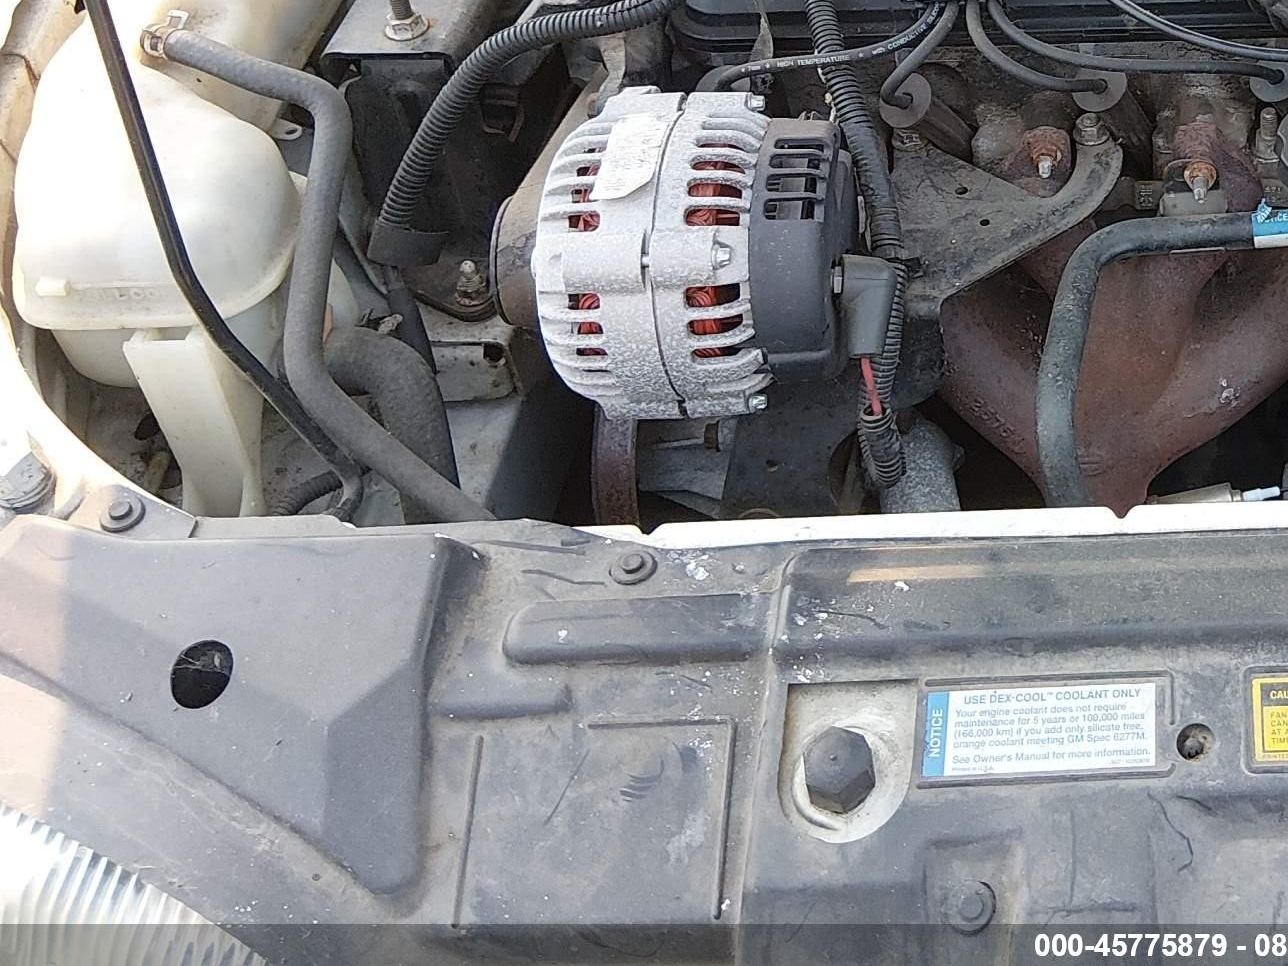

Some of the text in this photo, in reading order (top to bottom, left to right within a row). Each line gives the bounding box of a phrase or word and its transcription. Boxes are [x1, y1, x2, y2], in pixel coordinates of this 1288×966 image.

[777, 60, 794, 68] HIGH
[797, 54, 850, 66] TEMPERATURE
[964, 693, 986, 705] USE
[1056, 690, 1108, 701] COOLANT
[1112, 688, 1142, 699] ONLY
[956, 703, 1126, 718] Your engine coolant does not require
[1270, 711, 1288, 719] FAN
[954, 712, 1145, 728] maintenance for 5 years or 100,000 miles
[1270, 720, 1288, 728] CAN
[928, 708, 944, 758] NOTICE
[996, 727, 1014, 738] km)
[1016, 726, 1022, 736] if
[1024, 727, 1040, 738] you
[1041, 726, 1064, 736] add
[1065, 724, 1086, 736] only
[1088, 722, 1120, 732] silicate
[1271, 728, 1282, 736] AT
[953, 731, 1148, 751] orange coolant meeting GM Spec 6277M.
[952, 746, 1150, 765] See Owner's Manual for more information.
